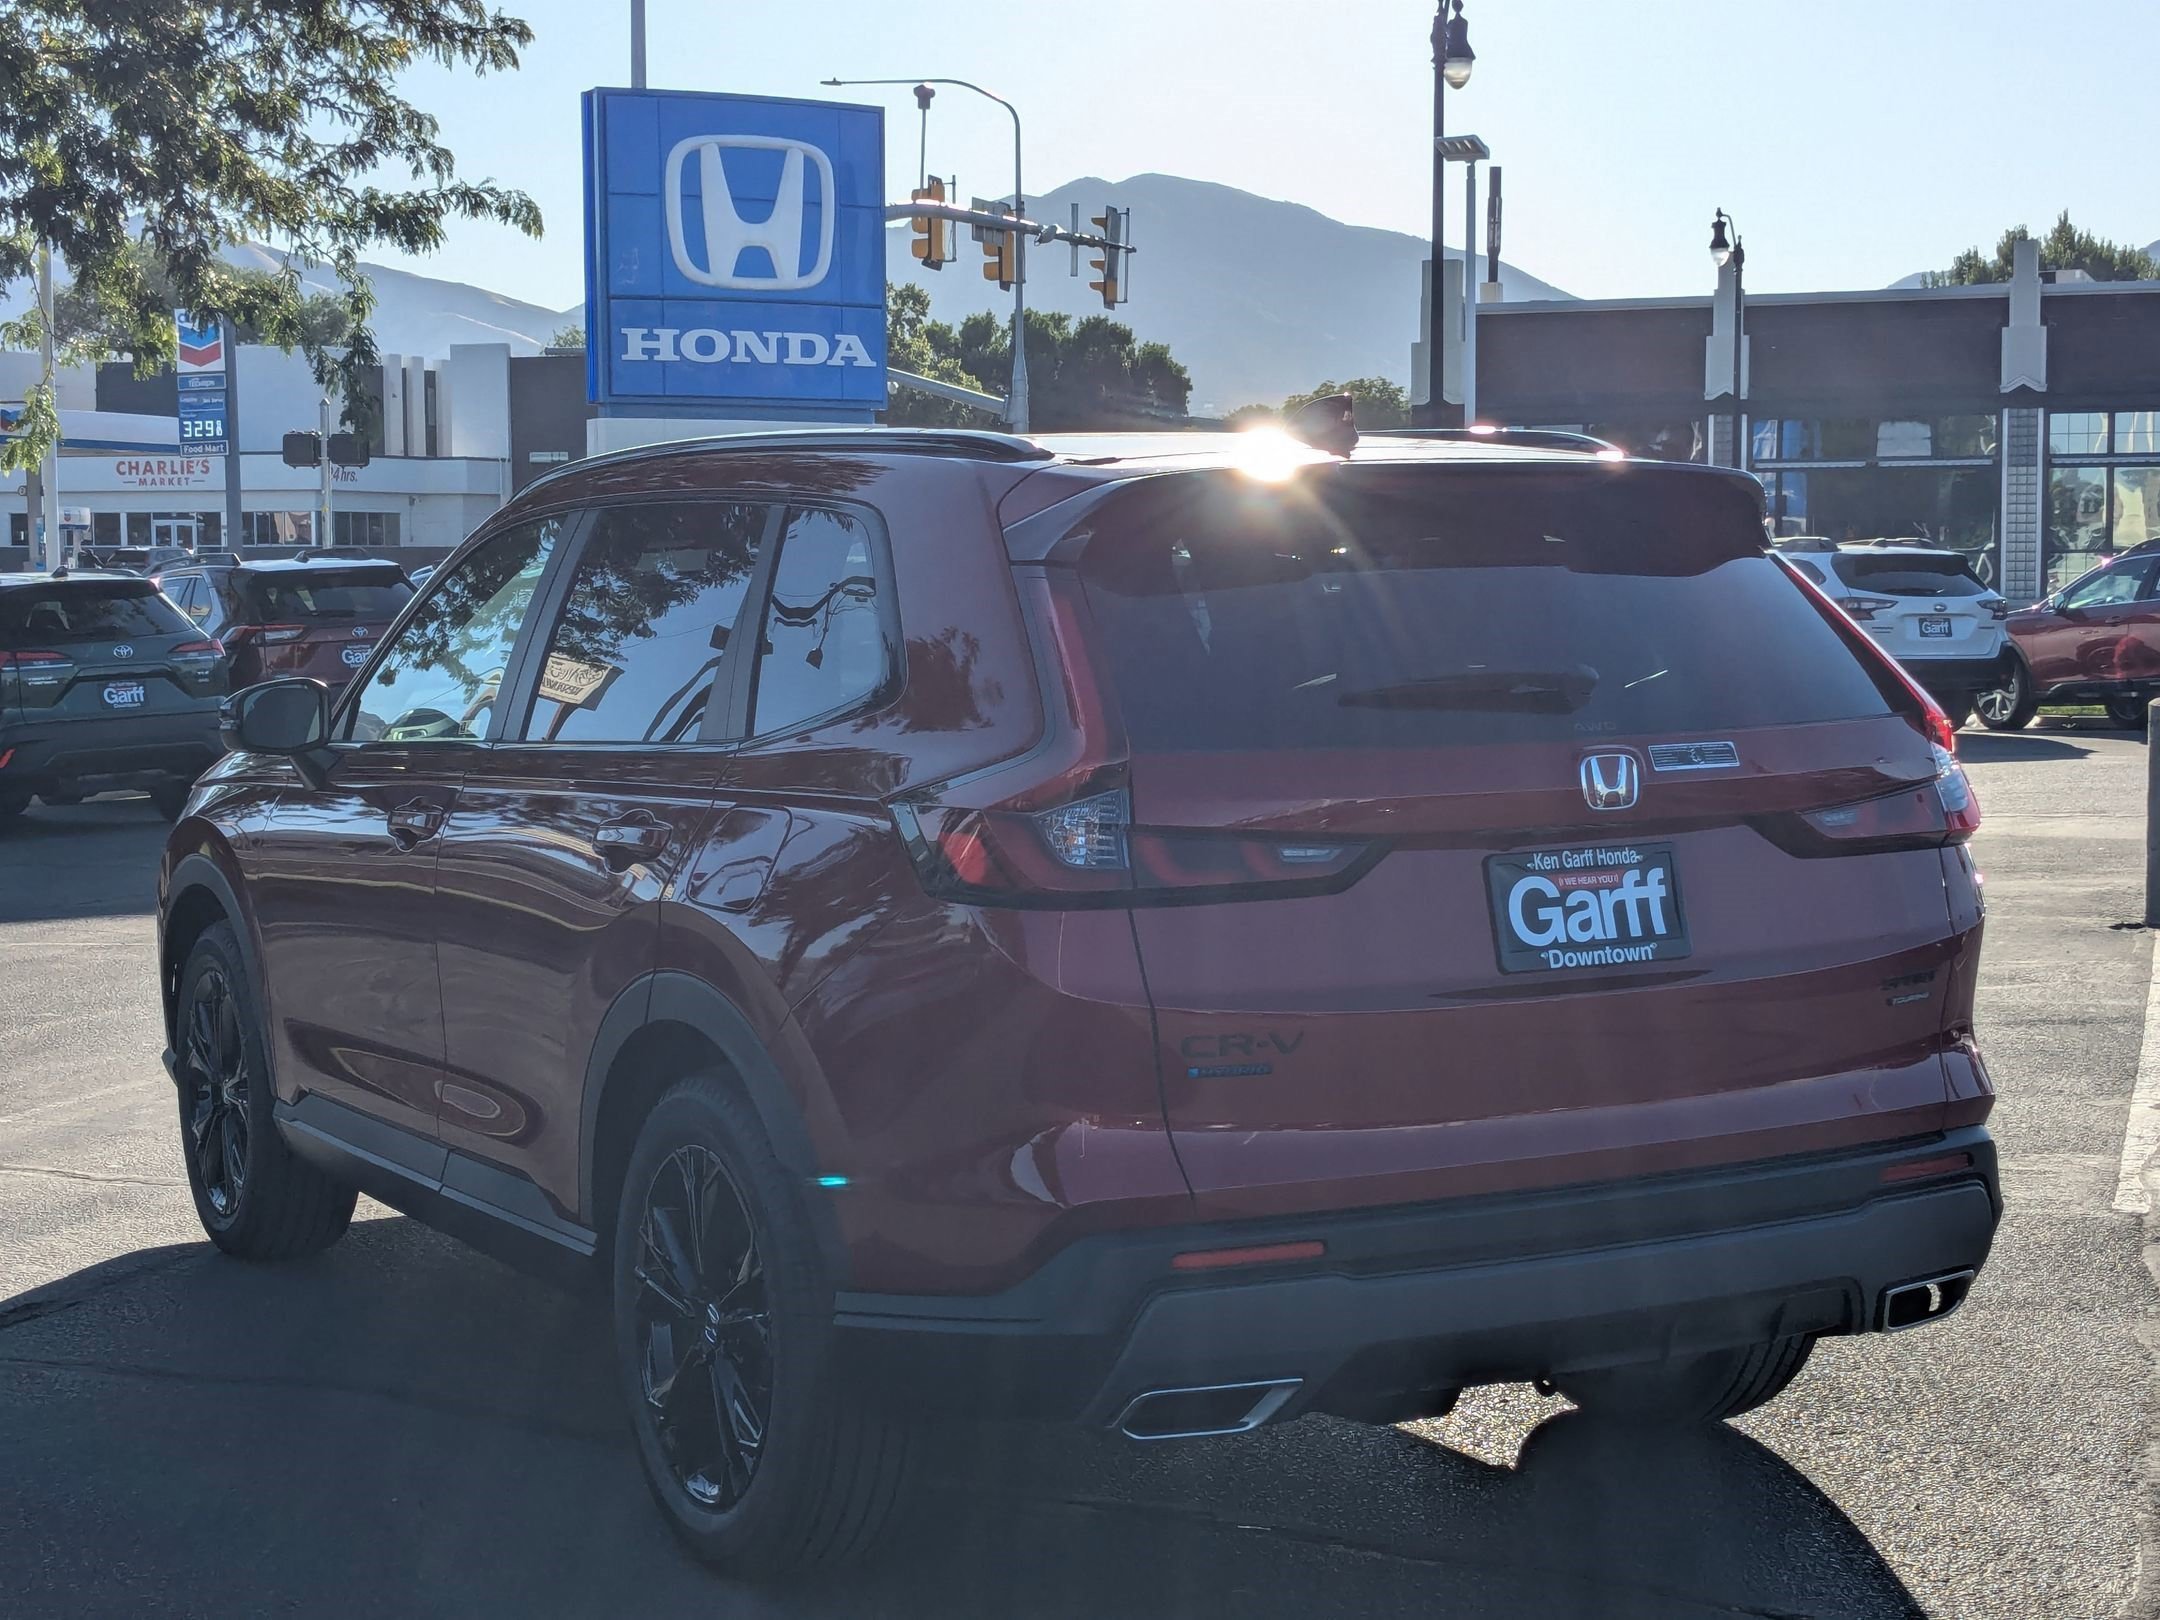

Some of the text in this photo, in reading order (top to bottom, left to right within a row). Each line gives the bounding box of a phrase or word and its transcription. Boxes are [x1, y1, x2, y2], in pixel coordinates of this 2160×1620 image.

[620, 327, 877, 367] HONDA
[183, 443, 225, 453] Food Mart
[116, 459, 210, 475] CHARLIE'S
[138, 477, 190, 486] MARKET
[1922, 621, 1949, 634] Garff
[342, 648, 371, 664] Gar
[103, 686, 144, 704] Garff
[1533, 847, 1638, 870] Ken Garff Honda
[1565, 874, 1613, 886] WE HEAR YOU
[1508, 867, 1667, 947] Garff
[1547, 943, 1653, 969] Downtown
